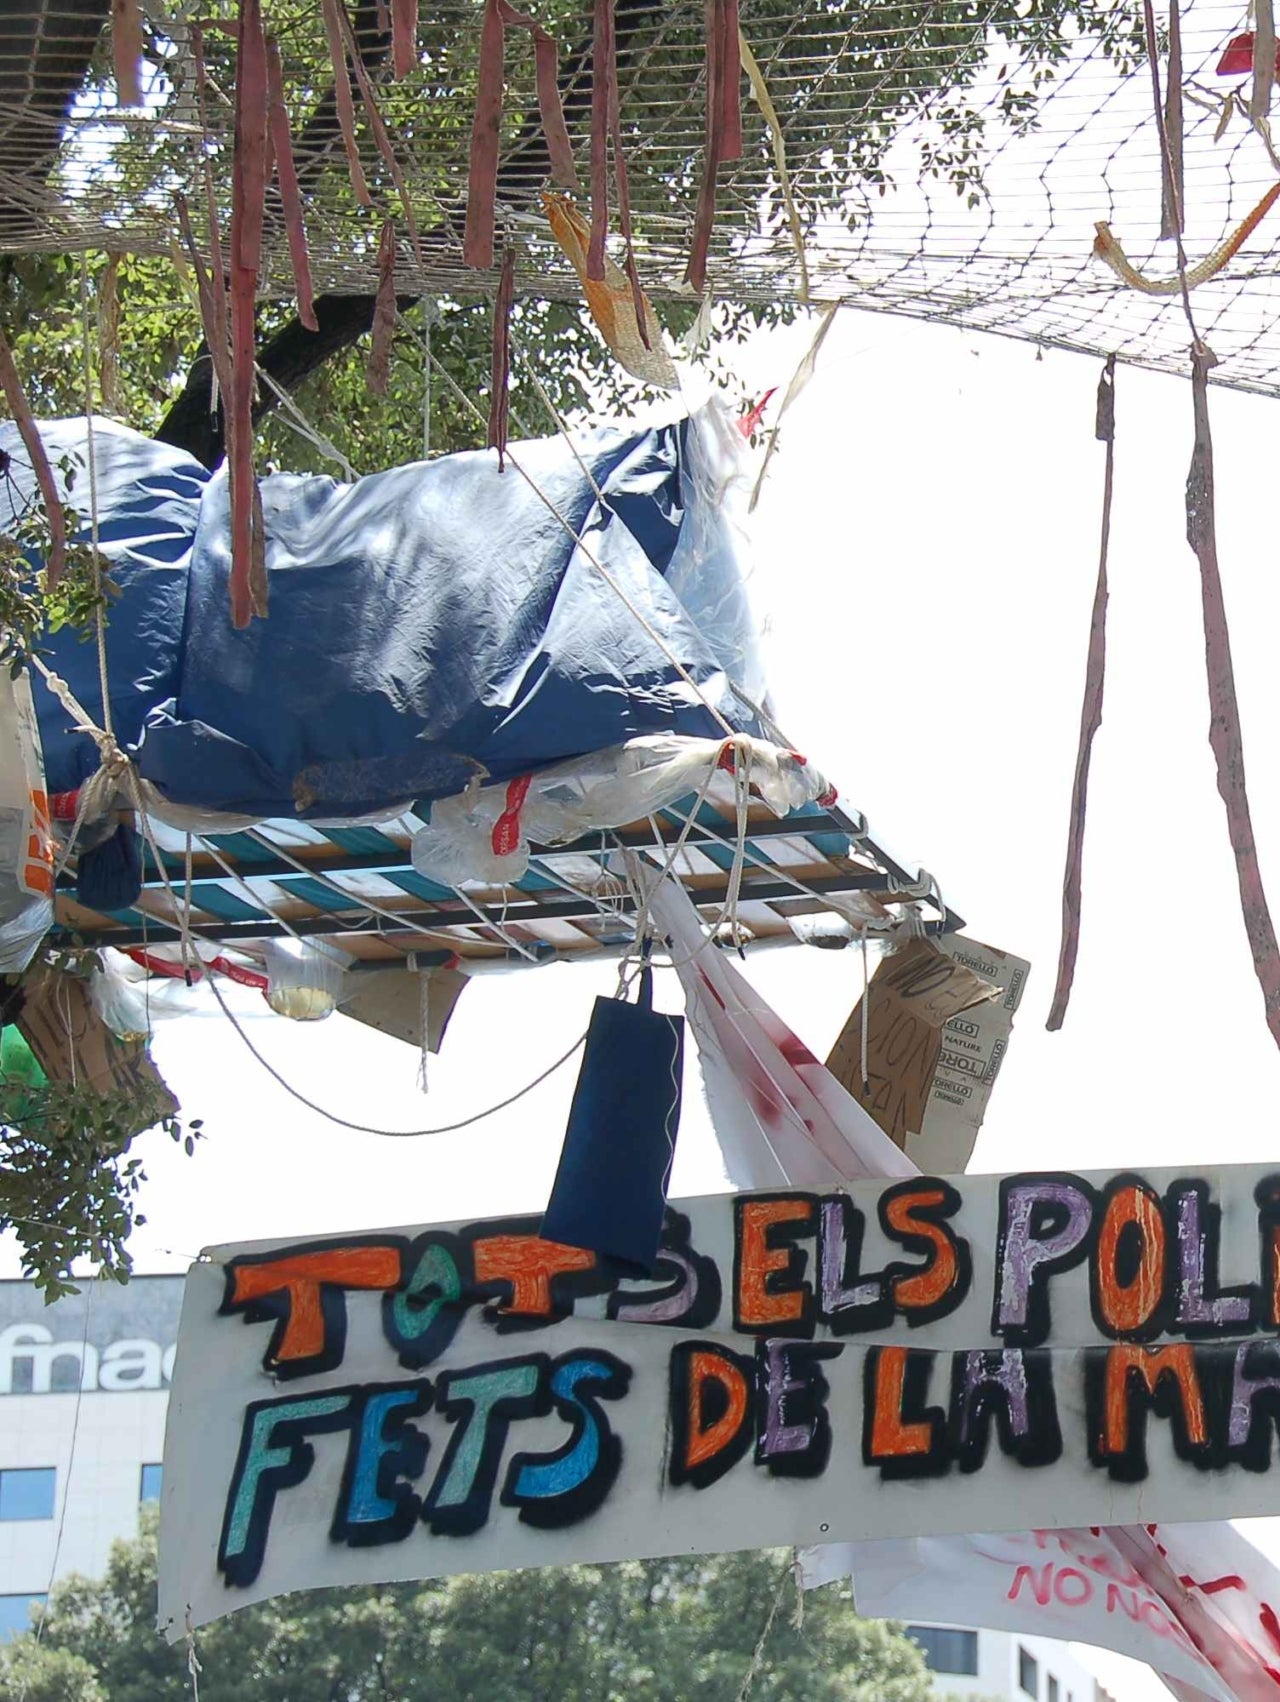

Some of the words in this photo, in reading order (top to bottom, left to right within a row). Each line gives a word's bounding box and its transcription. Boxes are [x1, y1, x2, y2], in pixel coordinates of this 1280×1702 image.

[944, 1035, 982, 1053] NATURE
[733, 1176, 972, 1340] ELS
[0, 1322, 178, 1394] fna
[217, 1347, 631, 1588] FETS
[669, 1337, 845, 1488] DE
[862, 1346, 1063, 1480] LA
[1008, 1561, 1094, 1607] NO
